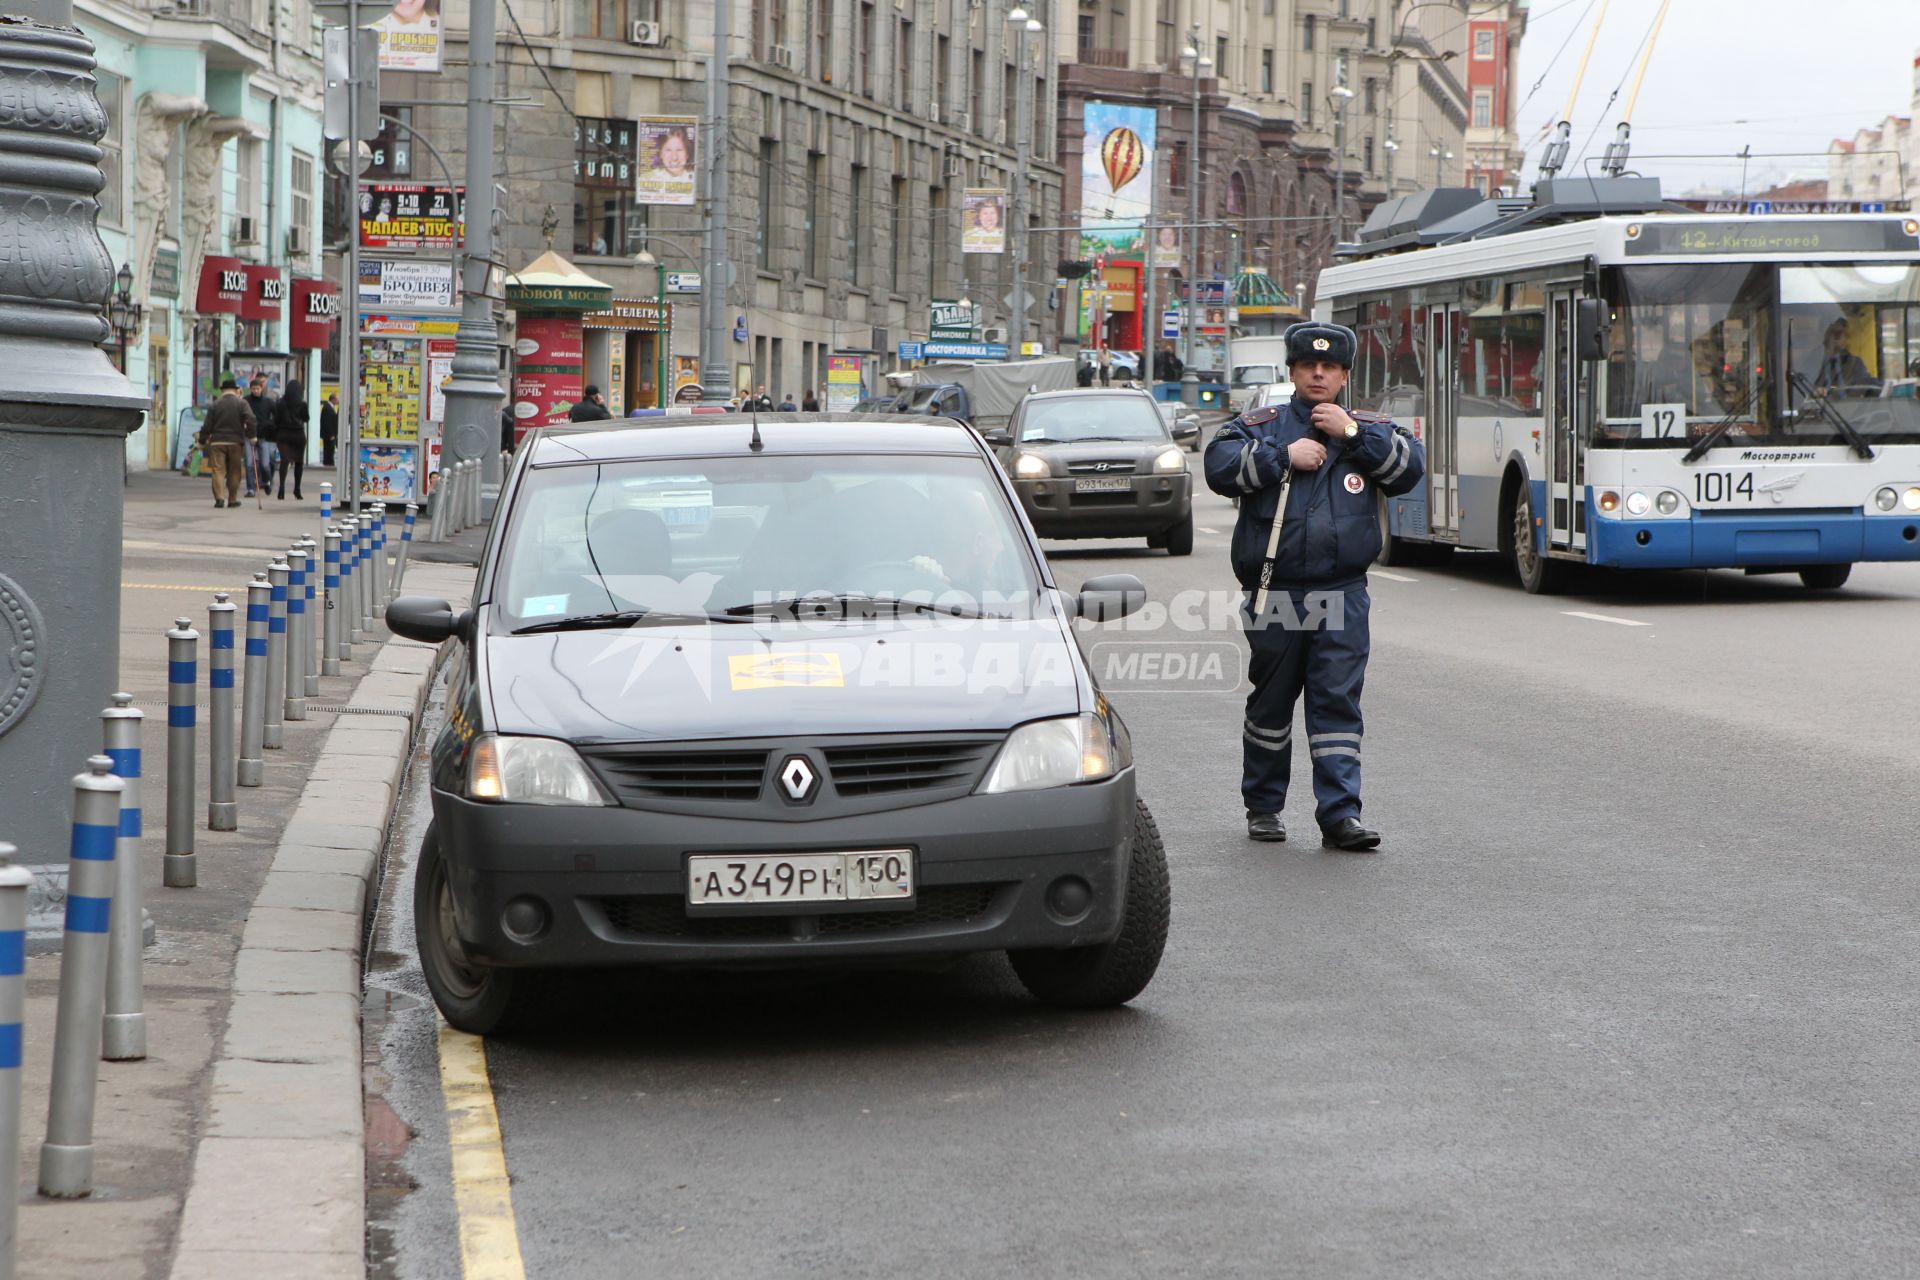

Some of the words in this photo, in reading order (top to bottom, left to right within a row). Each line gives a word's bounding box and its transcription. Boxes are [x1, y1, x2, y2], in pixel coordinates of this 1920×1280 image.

[434, 195, 444, 208] 21
[362, 220, 419, 236] ЧАПАЕВ
[384, 262, 396, 272] 17
[383, 281, 450, 293] БРОДВЕЯ
[931, 331, 970, 340] БАНКОМАТ
[925, 345, 987, 356] МОСГОРСПРАВКА
[1653, 411, 1676, 438] 12
[1740, 451, 1817, 462] Мосгортранс
[1694, 473, 1754, 502] 1014
[704, 862, 842, 897] А349РН
[855, 855, 901, 883] 150
